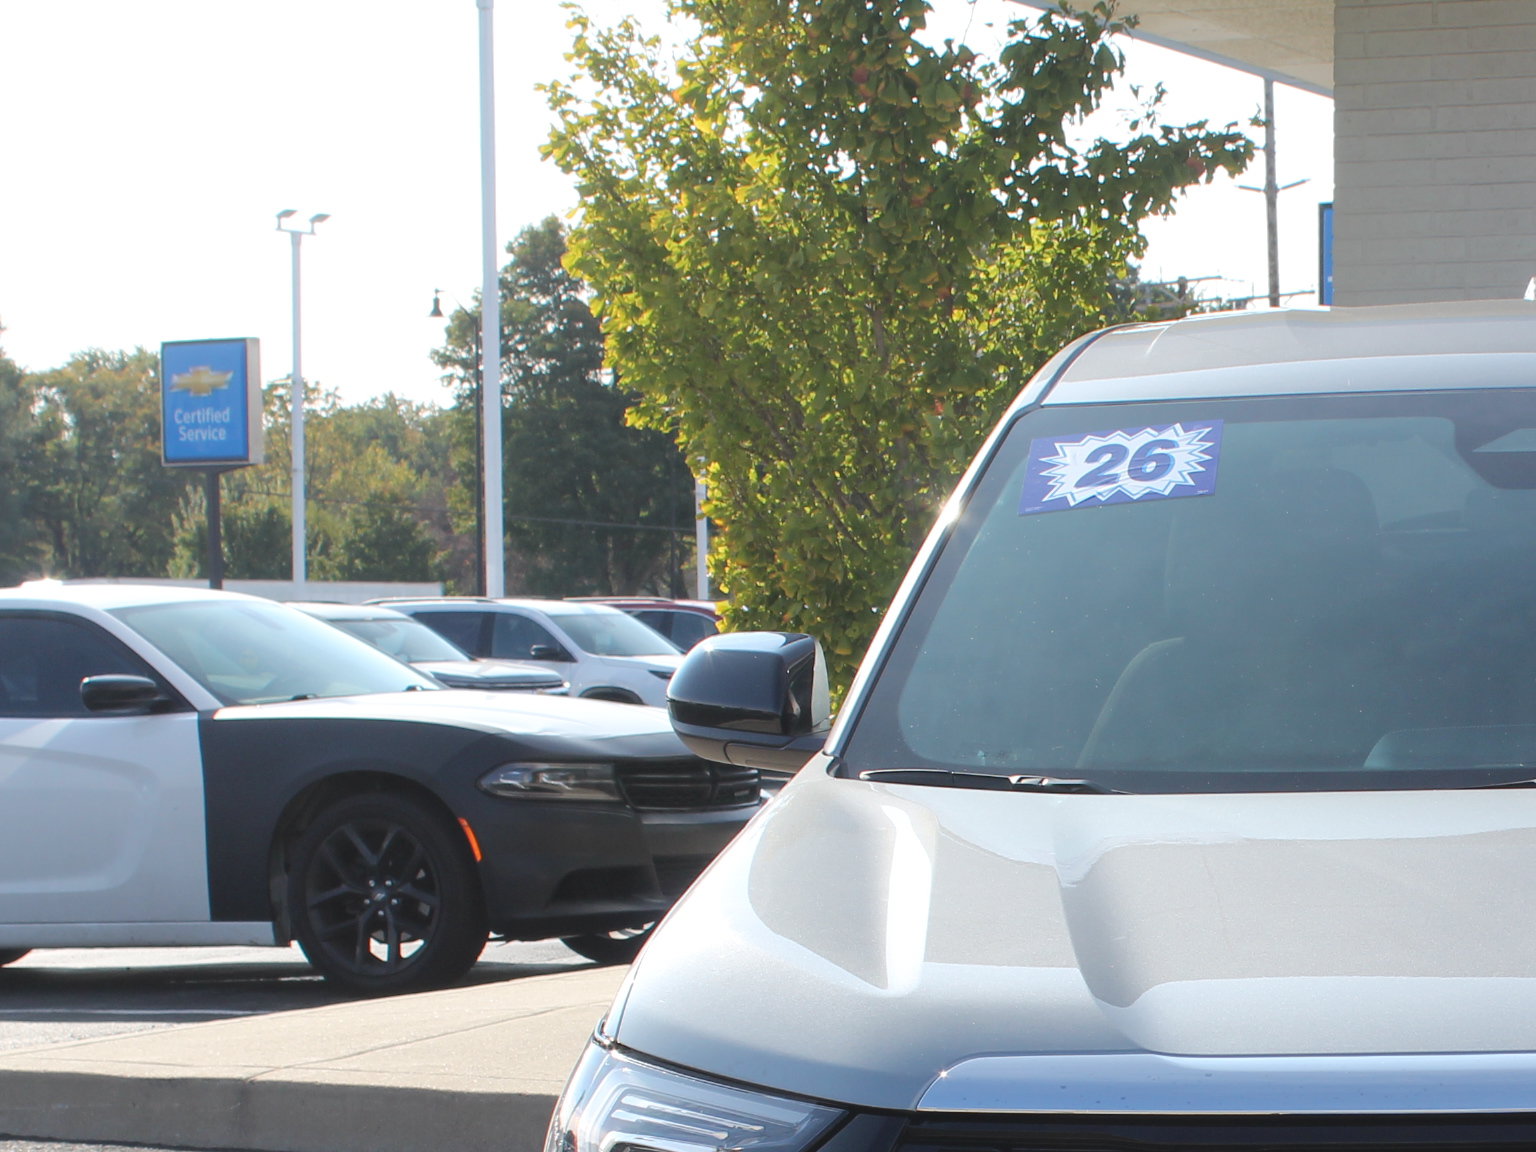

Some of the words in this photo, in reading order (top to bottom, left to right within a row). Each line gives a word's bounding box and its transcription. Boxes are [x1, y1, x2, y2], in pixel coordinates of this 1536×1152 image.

[174, 407, 231, 424] Certified
[179, 425, 227, 442] Service
[1073, 438, 1180, 489] 26
